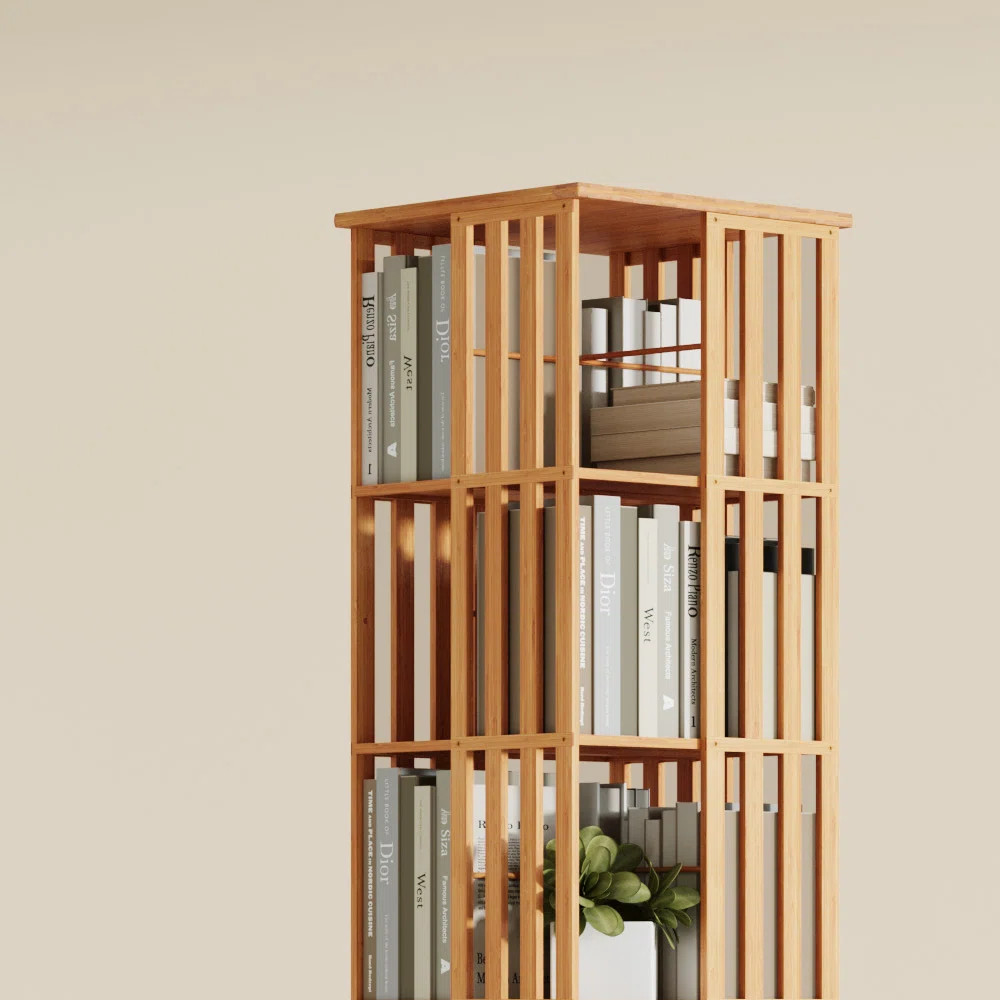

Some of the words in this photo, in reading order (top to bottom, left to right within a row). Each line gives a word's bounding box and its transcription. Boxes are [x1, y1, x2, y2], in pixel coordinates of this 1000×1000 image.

[663, 565, 674, 592] Siza
[688, 546, 700, 580] Renzo
[600, 572, 616, 616] Dior
[688, 584, 700, 618] Piano
[644, 608, 654, 642] West
[440, 830, 450, 856] Siza
[380, 842, 394, 885] Dior
[416, 874, 427, 908] West
